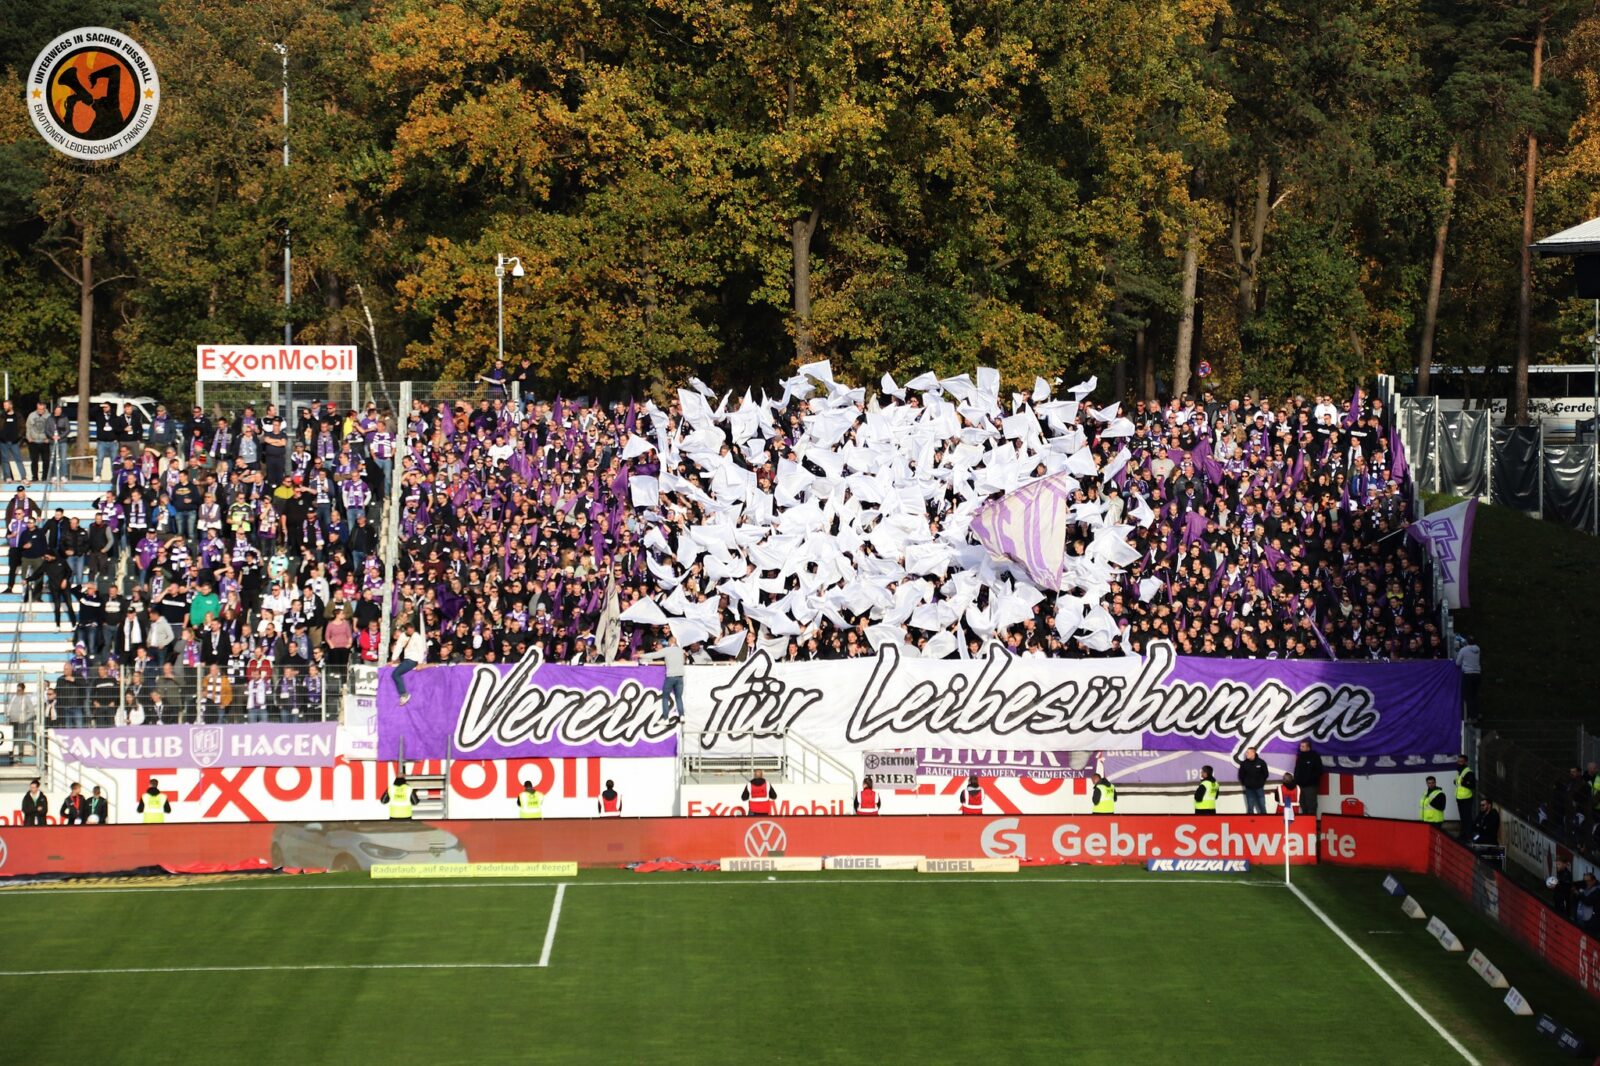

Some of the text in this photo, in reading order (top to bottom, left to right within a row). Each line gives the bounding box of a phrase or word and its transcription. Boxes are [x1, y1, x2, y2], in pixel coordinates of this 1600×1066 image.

[202, 348, 353, 378] ExxonMobil
[458, 641, 1378, 764] Verein für Leibesübungen
[57, 734, 184, 760] FANCLUB
[231, 734, 332, 758] HAGEN
[880, 756, 915, 767] SEKTION
[865, 774, 915, 784] TRIER
[925, 767, 1085, 779] RAUCHEN SAUFEN SCHMEISSEN
[688, 799, 845, 817] ExxoMobil
[1052, 822, 1356, 858] Gebr. Schwarte
[833, 857, 882, 869] NÖGEL
[926, 860, 975, 872] NÖGEL
[1175, 859, 1224, 871] KUZKA
